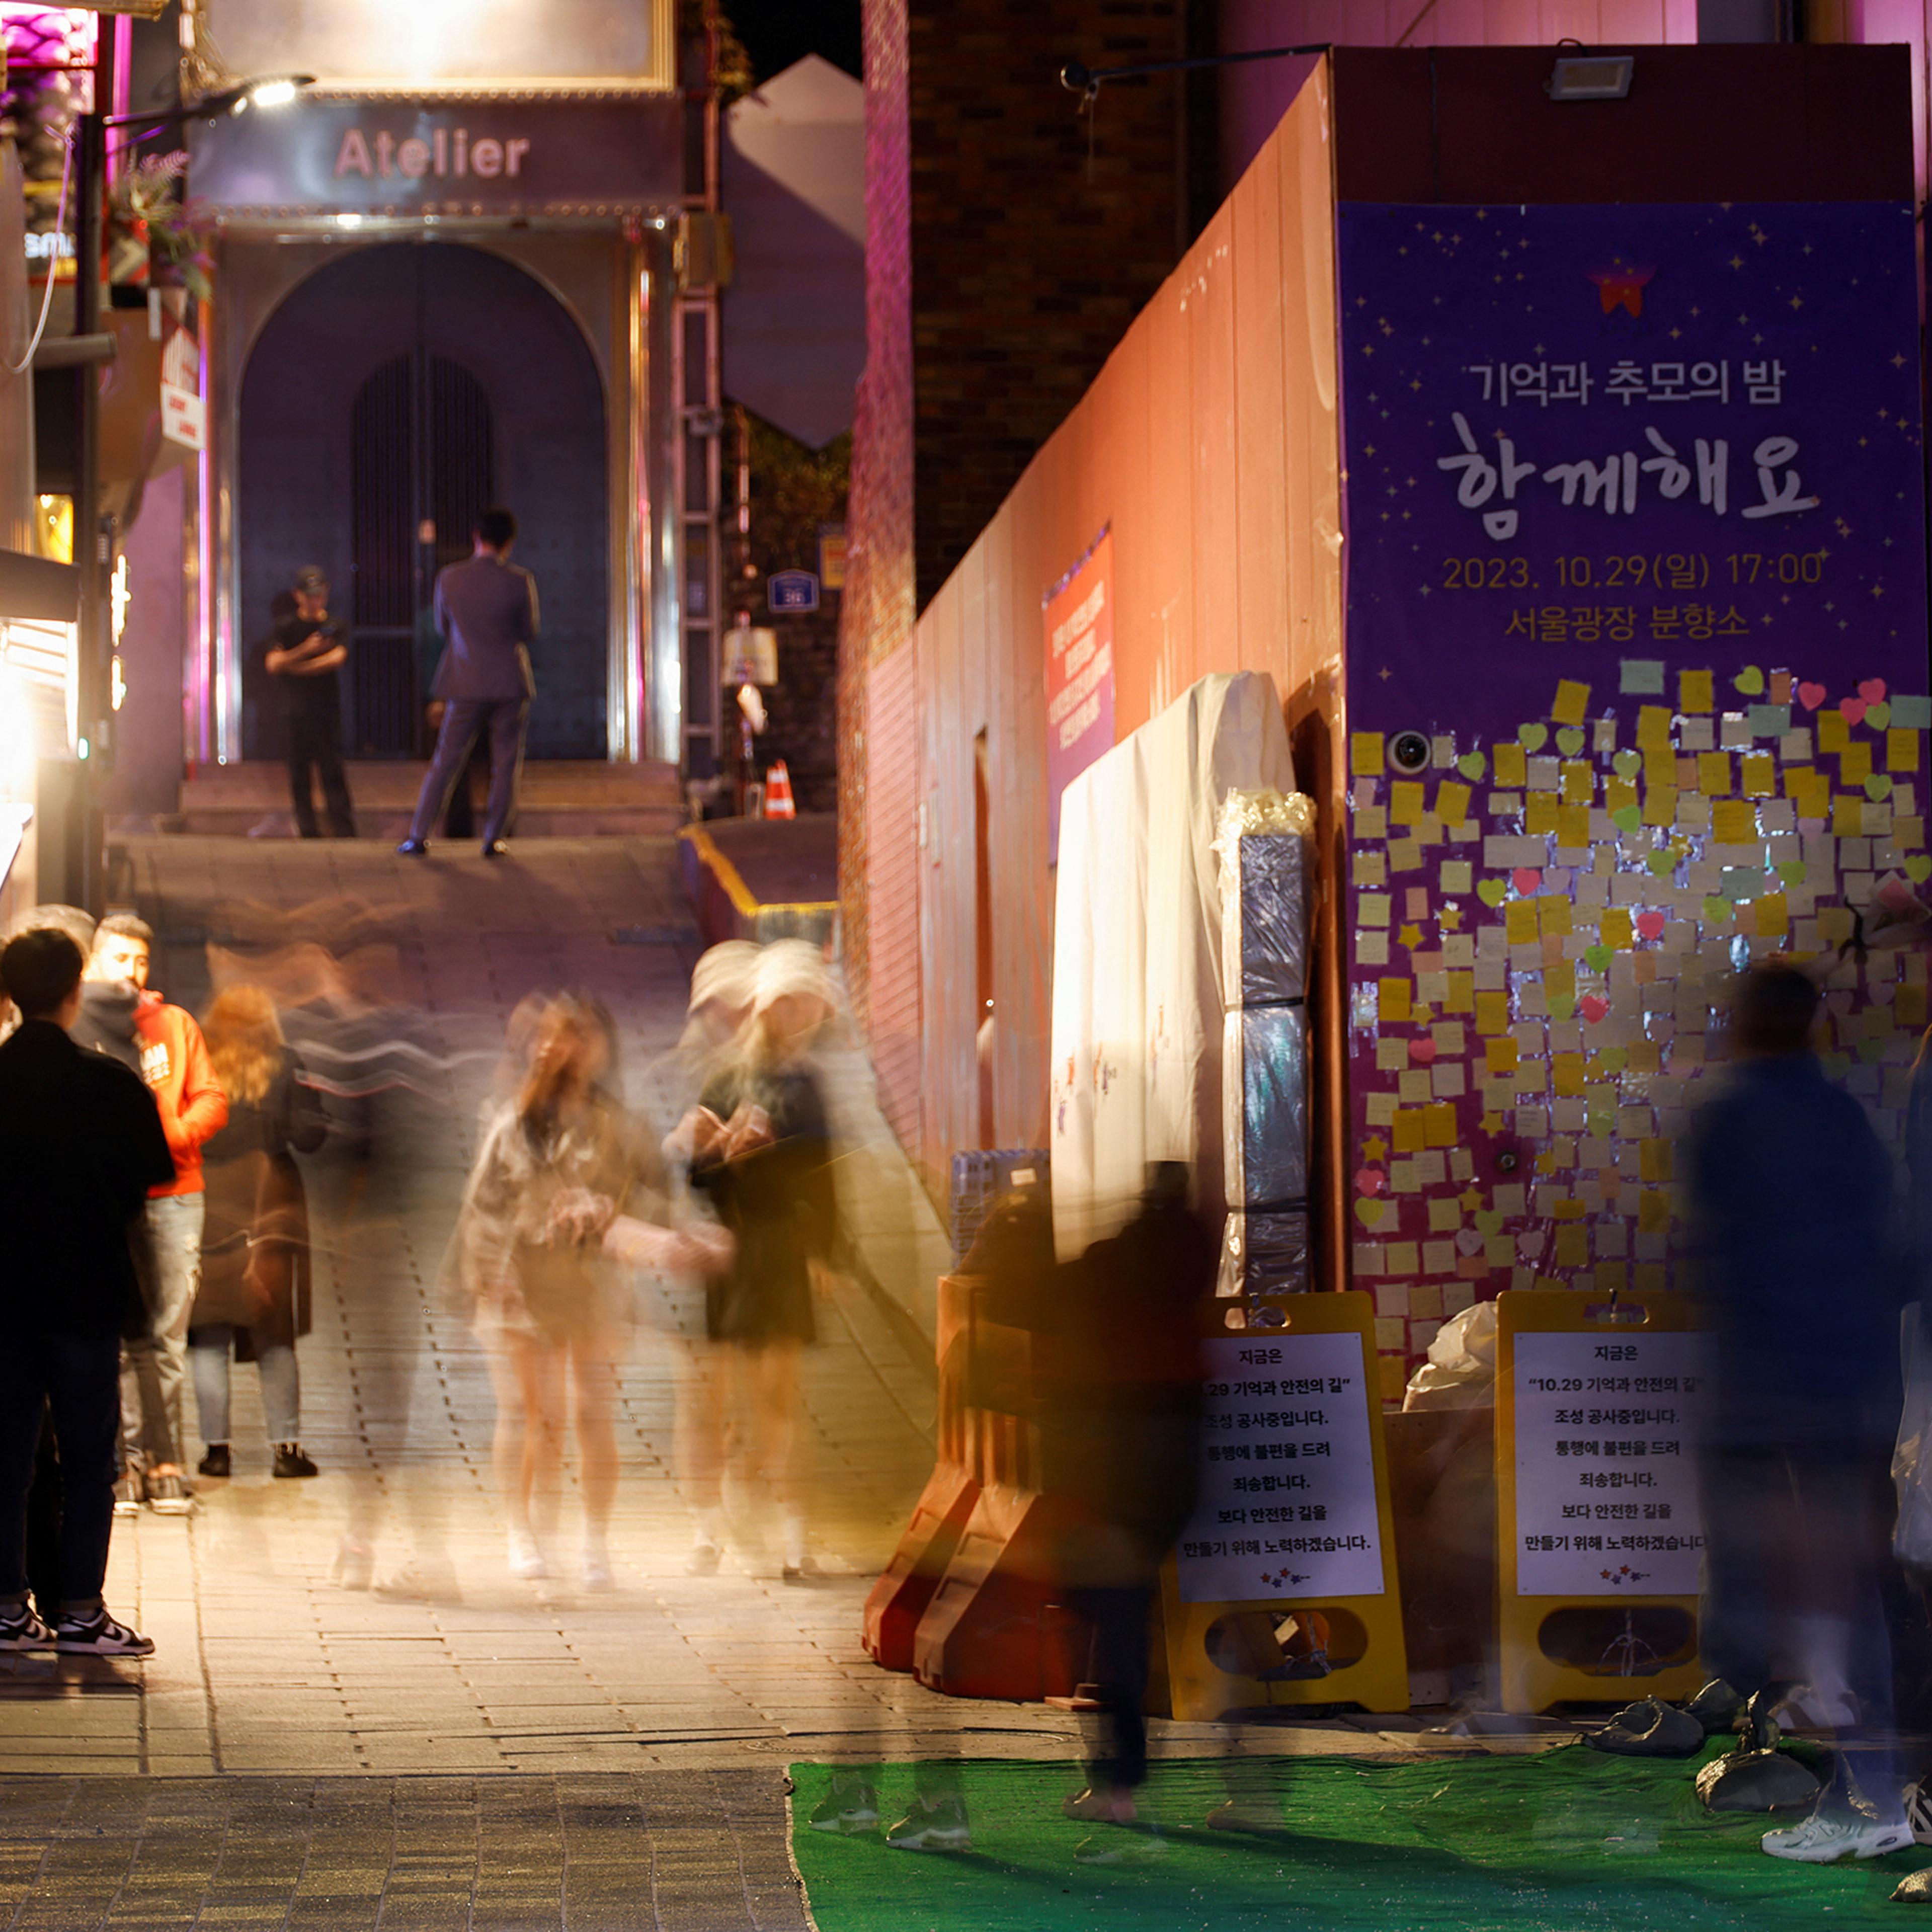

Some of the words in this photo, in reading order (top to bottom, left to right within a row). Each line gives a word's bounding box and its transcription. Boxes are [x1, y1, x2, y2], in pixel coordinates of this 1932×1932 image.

[336, 127, 530, 178] Atelier
[1469, 362, 1594, 407] 기억과
[1604, 360, 1728, 406] 추모의
[1743, 360, 1786, 404] 밤
[1443, 559, 1539, 589] 2023.
[1555, 553, 1709, 589] 10.29(일)
[1727, 553, 1821, 585] 17:00
[1505, 605, 1636, 641] 서울광장
[1649, 603, 1748, 639] 분향소
[1240, 1348, 1283, 1364] 지금은
[1594, 1345, 1638, 1361] 지금은
[1234, 1380, 1277, 1396] 기억과
[1280, 1378, 1324, 1395] 안전의
[1586, 1377, 1631, 1393] 기억과
[1634, 1377, 1677, 1393] 안전의
[1205, 1414, 1232, 1429] 조성
[1238, 1410, 1328, 1428] 공사중입니다.
[1555, 1409, 1583, 1424] 조성
[1587, 1409, 1679, 1424] 공사중입니다.
[1208, 1445, 1251, 1461] 통행에
[1254, 1443, 1298, 1460] 불편을
[1302, 1441, 1330, 1457] 드려
[1555, 1441, 1599, 1456] 통행에
[1603, 1441, 1646, 1456] 불편을
[1650, 1440, 1679, 1456] 드려
[1234, 1474, 1310, 1492] 죄송합니다.
[1579, 1472, 1657, 1488] 죄송합니다.
[1218, 1508, 1247, 1524] 보다
[1250, 1506, 1294, 1523] 안전한
[1299, 1505, 1327, 1521] 길을
[1562, 1504, 1591, 1519] 보다
[1594, 1504, 1639, 1519] 안전한
[1643, 1504, 1671, 1519] 길을
[1184, 1541, 1227, 1558] 만들기
[1232, 1540, 1260, 1555] 위해
[1265, 1535, 1371, 1553] 노력하겠습니다.
[1525, 1536, 1569, 1551] 만들기
[1573, 1536, 1602, 1551] 위해
